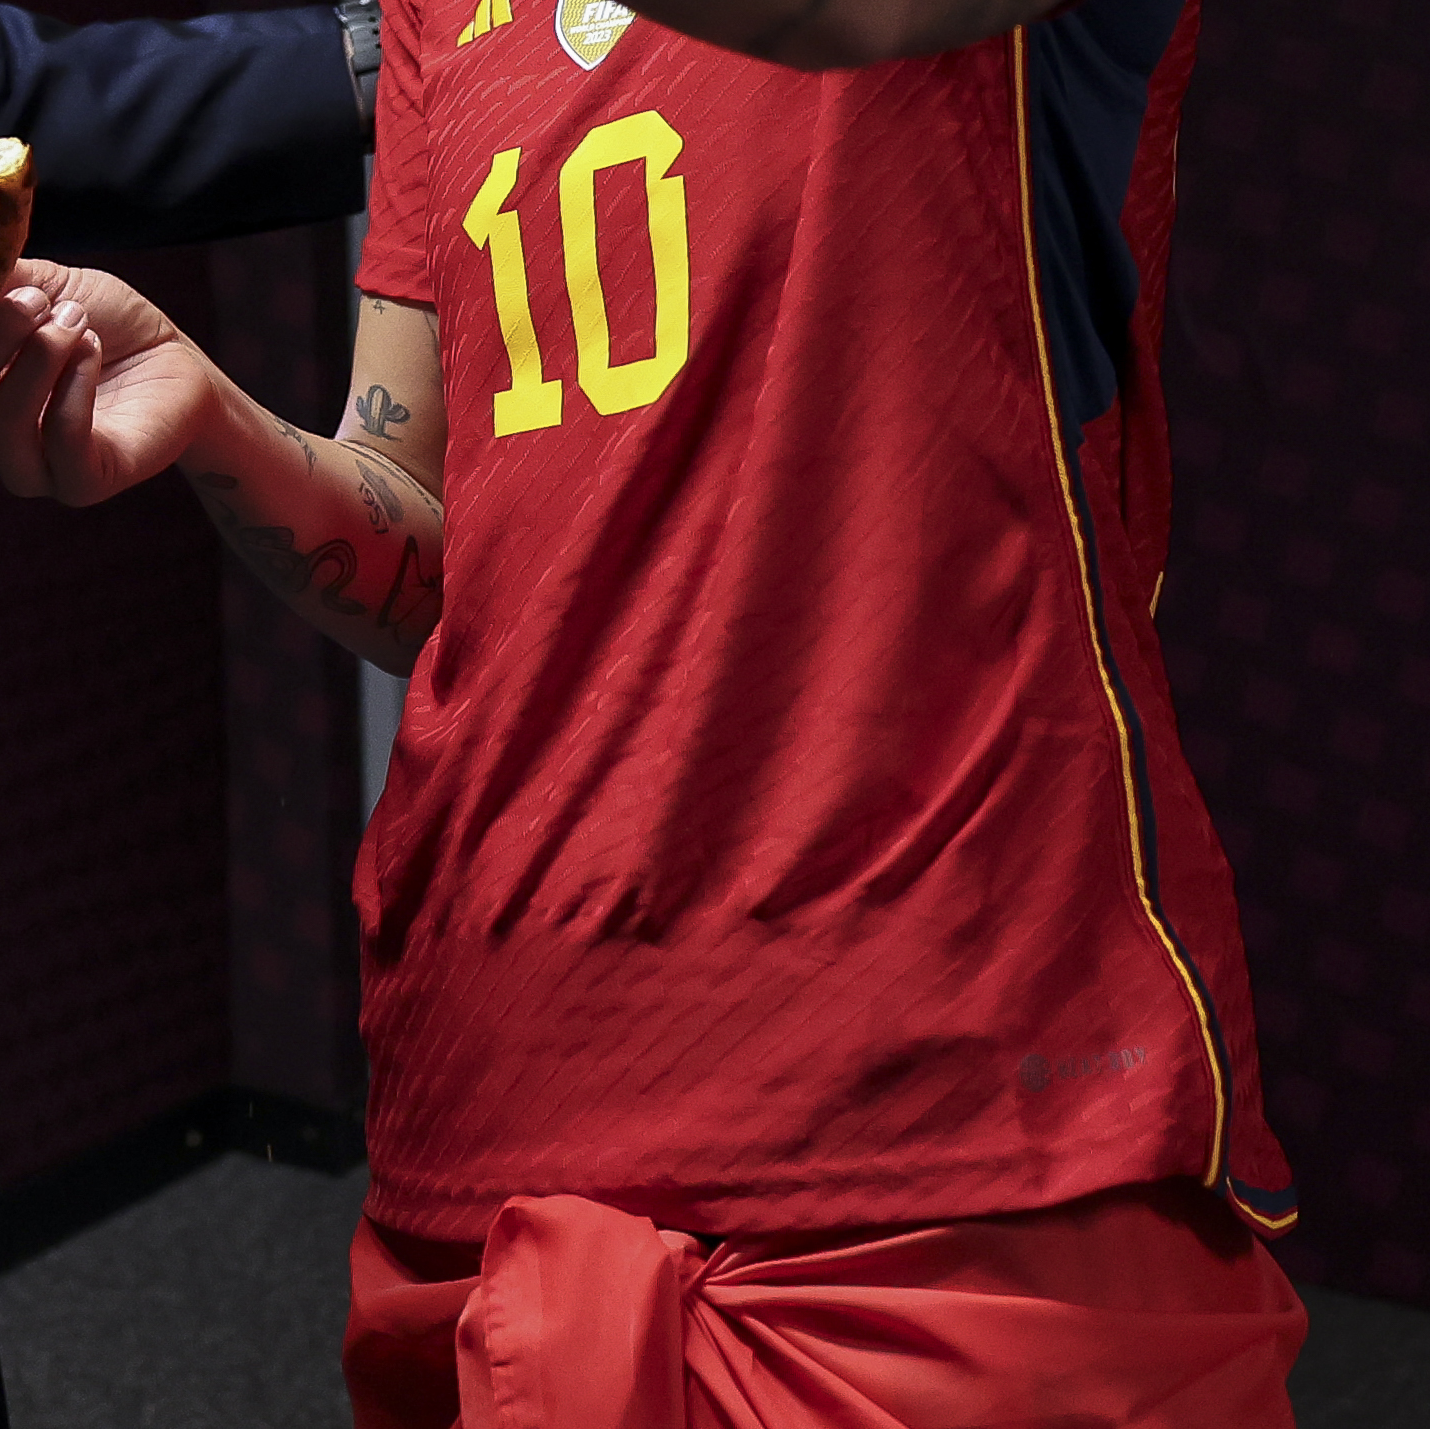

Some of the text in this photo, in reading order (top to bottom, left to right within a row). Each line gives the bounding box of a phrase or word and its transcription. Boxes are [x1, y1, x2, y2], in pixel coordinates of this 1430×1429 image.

[582, 0, 629, 23] FIFA
[583, 30, 612, 45] 2023
[461, 109, 691, 438] 10
